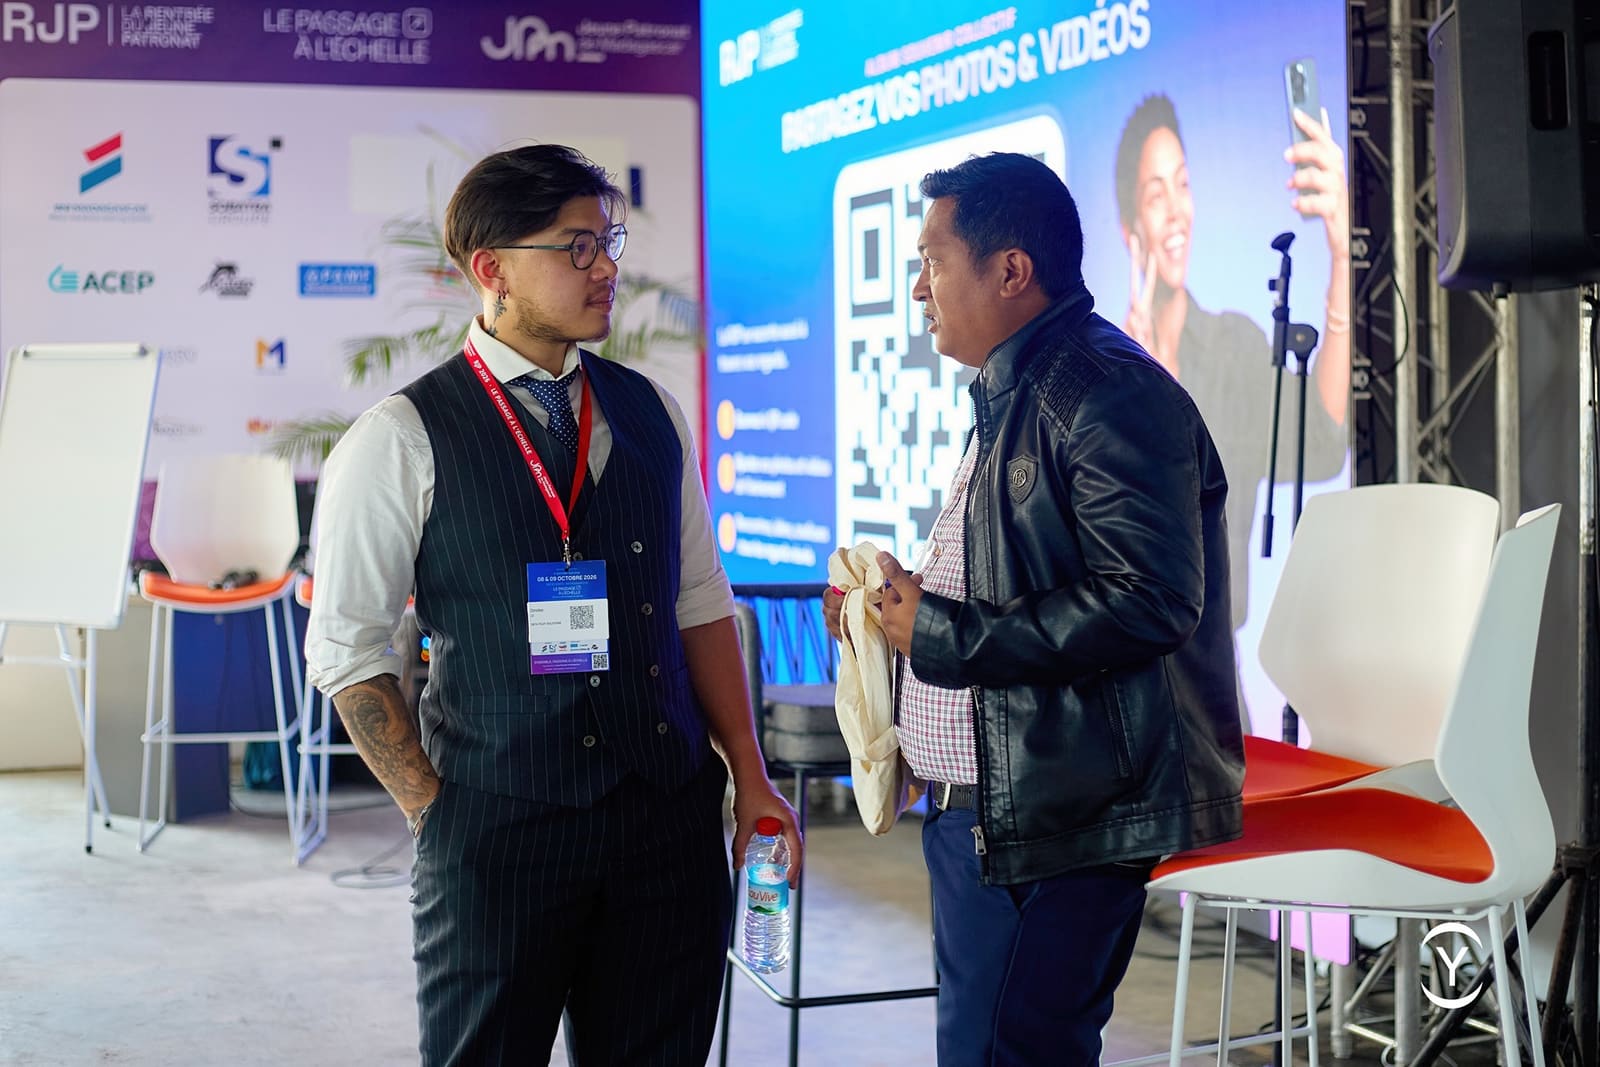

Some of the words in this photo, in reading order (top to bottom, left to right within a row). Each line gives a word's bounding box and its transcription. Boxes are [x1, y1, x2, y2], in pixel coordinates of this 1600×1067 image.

[3, 2, 99, 44] RJP
[121, 6, 140, 19] LA
[264, 8, 293, 32] LE
[295, 9, 400, 37] PASSAGE
[121, 32, 201, 48] PATRONAT
[875, 71, 921, 124] VOS
[920, 40, 1017, 111] PHOTOS
[1017, 33, 1039, 82] &
[1038, 0, 1151, 74] VIDÉOS
[83, 271, 155, 293] ACEP
[478, 369, 490, 383] 2026
[490, 388, 498, 397] LE
[495, 394, 512, 421] PASSAGE
